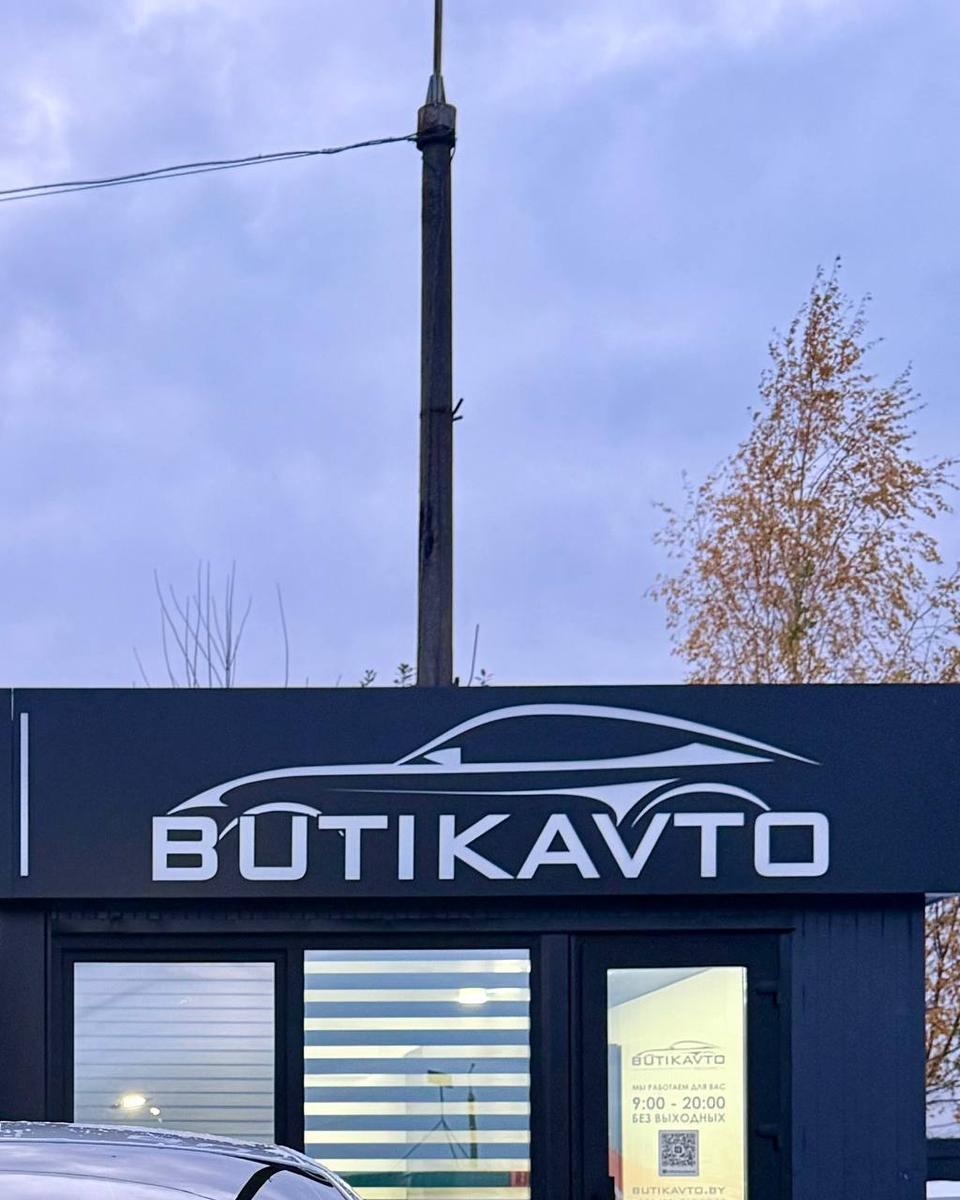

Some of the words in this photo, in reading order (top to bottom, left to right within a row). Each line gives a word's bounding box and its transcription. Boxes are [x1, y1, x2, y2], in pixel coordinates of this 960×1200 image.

[152, 811, 830, 881] BUTIKAVTO
[632, 1055, 725, 1066] BUTIKAVTO
[691, 1083, 707, 1091] ДЛЯ
[709, 1083, 726, 1091] ВАС
[632, 1096, 665, 1110] 9:00
[682, 1096, 726, 1109] 20:00
[632, 1113, 651, 1123] БЕЗ
[655, 1113, 726, 1123] ВЫХОДНЫХ
[632, 1186, 726, 1195] BUTIKAVTO.BY
